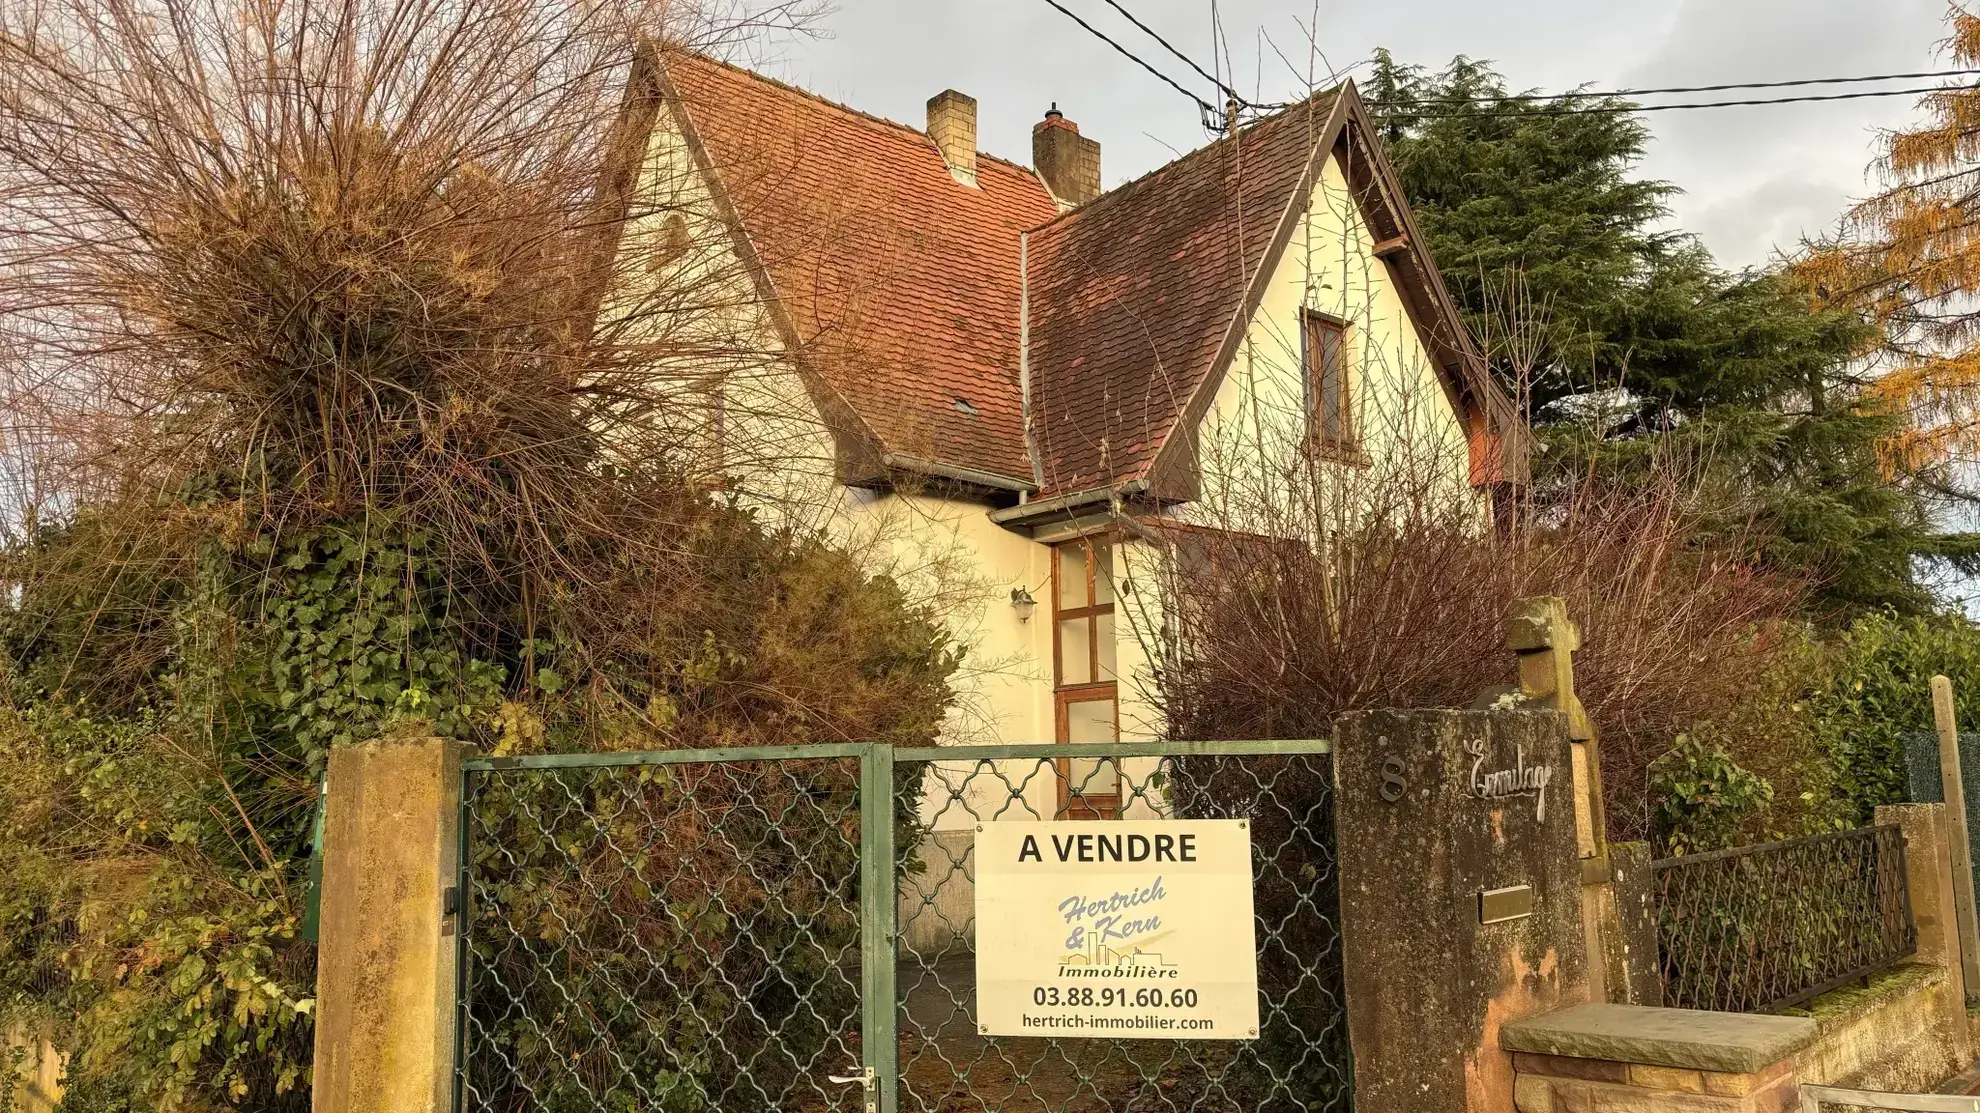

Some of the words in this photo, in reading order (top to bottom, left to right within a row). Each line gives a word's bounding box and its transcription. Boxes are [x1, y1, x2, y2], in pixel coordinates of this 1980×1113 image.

[1379, 757, 1407, 802] 8
[1018, 834, 1042, 863] A
[1052, 834, 1197, 862] VENDRE
[1058, 875, 1167, 924] Hertrich
[1065, 926, 1085, 950] &
[1094, 914, 1162, 943] Kern
[1058, 965, 1178, 979] Immobilière
[1033, 987, 1198, 1008] 03.88.91.60.60
[1022, 1014, 1214, 1030] hertrich-immobilier.com
